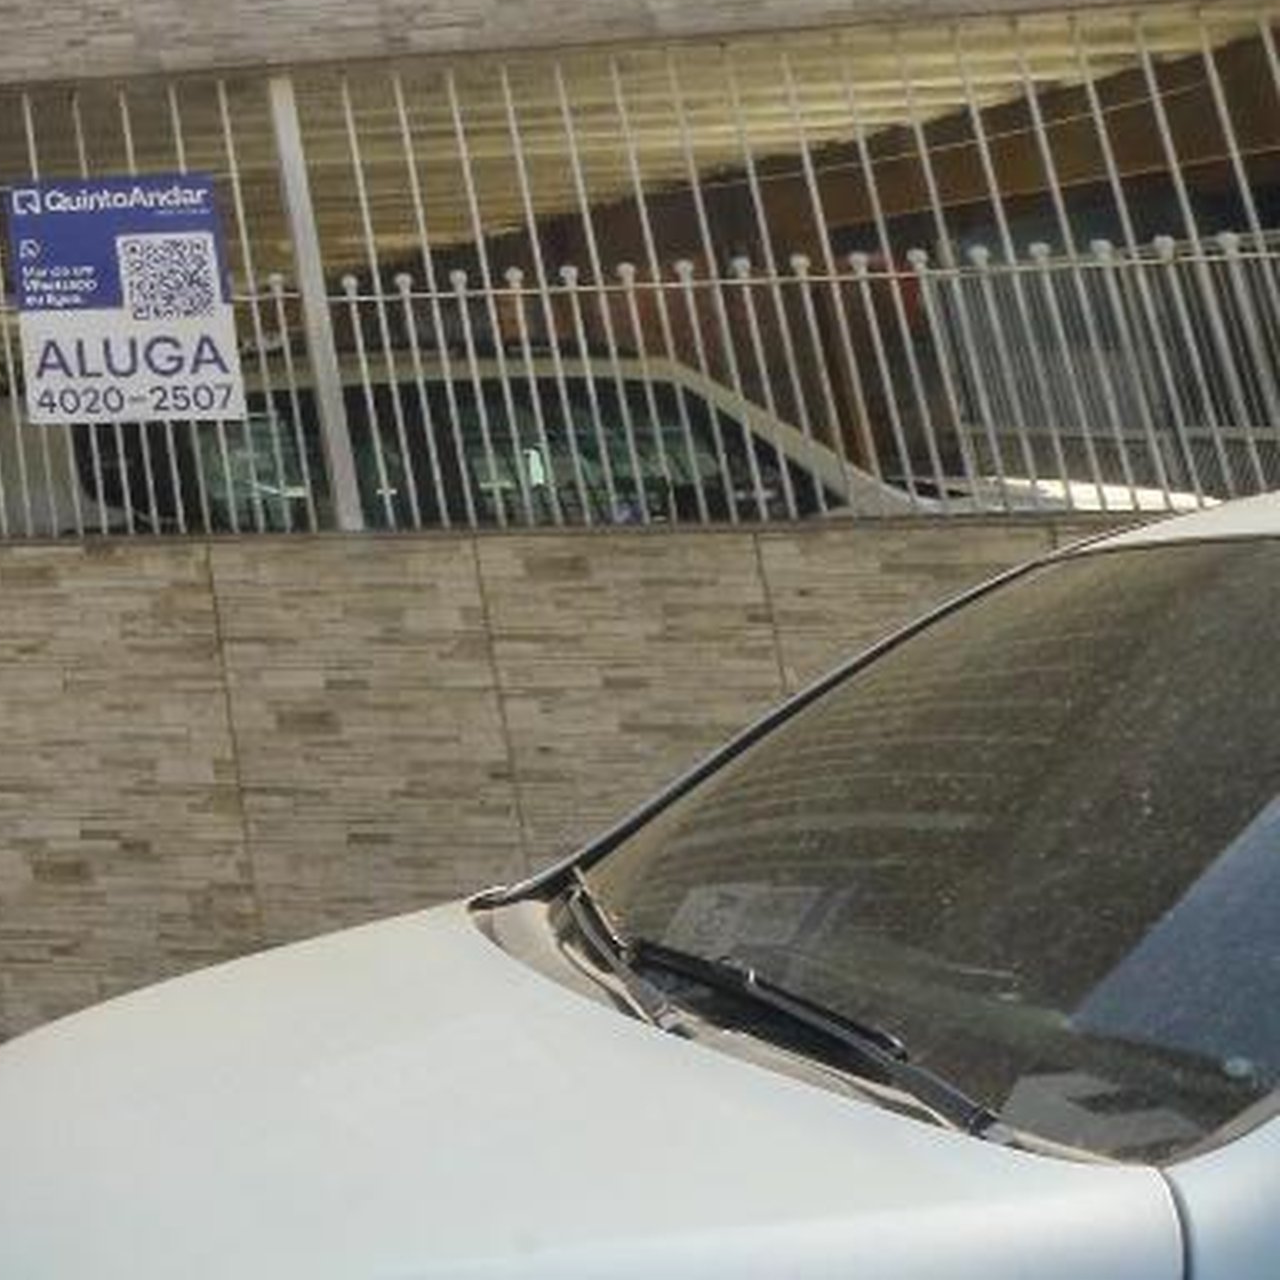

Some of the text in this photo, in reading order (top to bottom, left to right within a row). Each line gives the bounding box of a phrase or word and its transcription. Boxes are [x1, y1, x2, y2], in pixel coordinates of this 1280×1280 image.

[44, 186, 208, 212] QuintoAndar
[36, 335, 230, 379] ALUGA
[38, 385, 233, 415] 4020-2507
